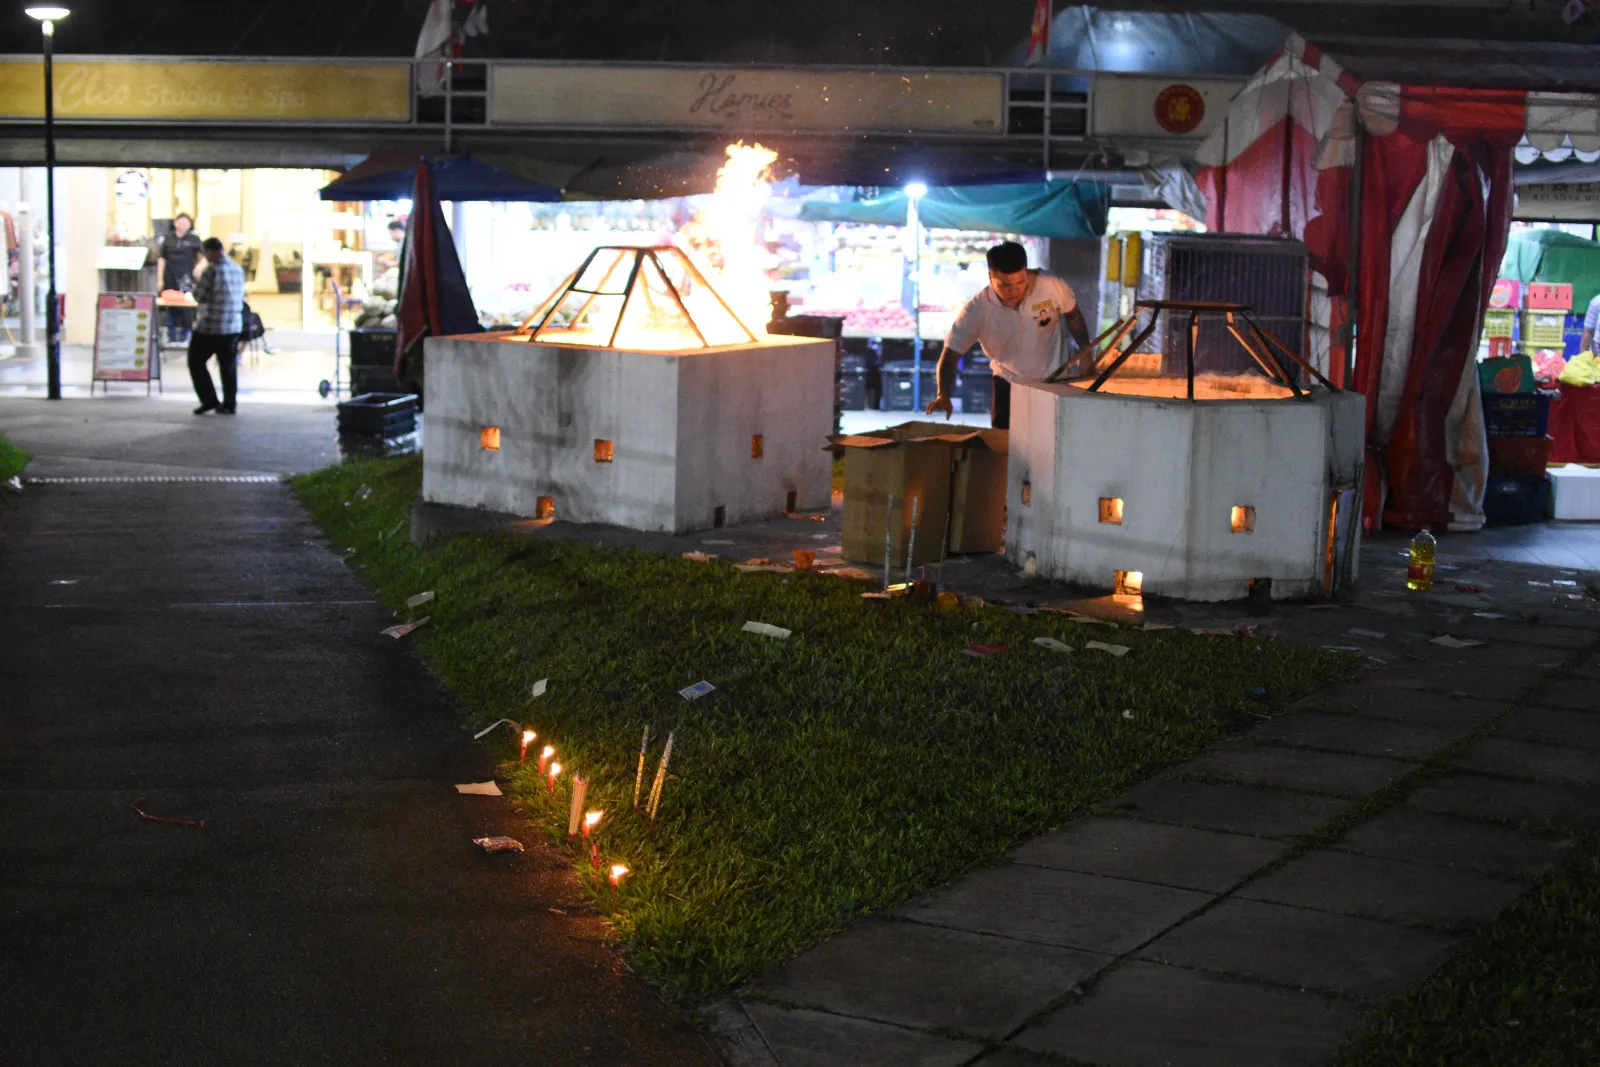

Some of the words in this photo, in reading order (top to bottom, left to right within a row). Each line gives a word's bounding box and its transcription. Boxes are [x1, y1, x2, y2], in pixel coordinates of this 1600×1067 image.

[53, 62, 130, 112] Clio
[140, 83, 222, 107] Studio
[689, 72, 793, 114] Homies
